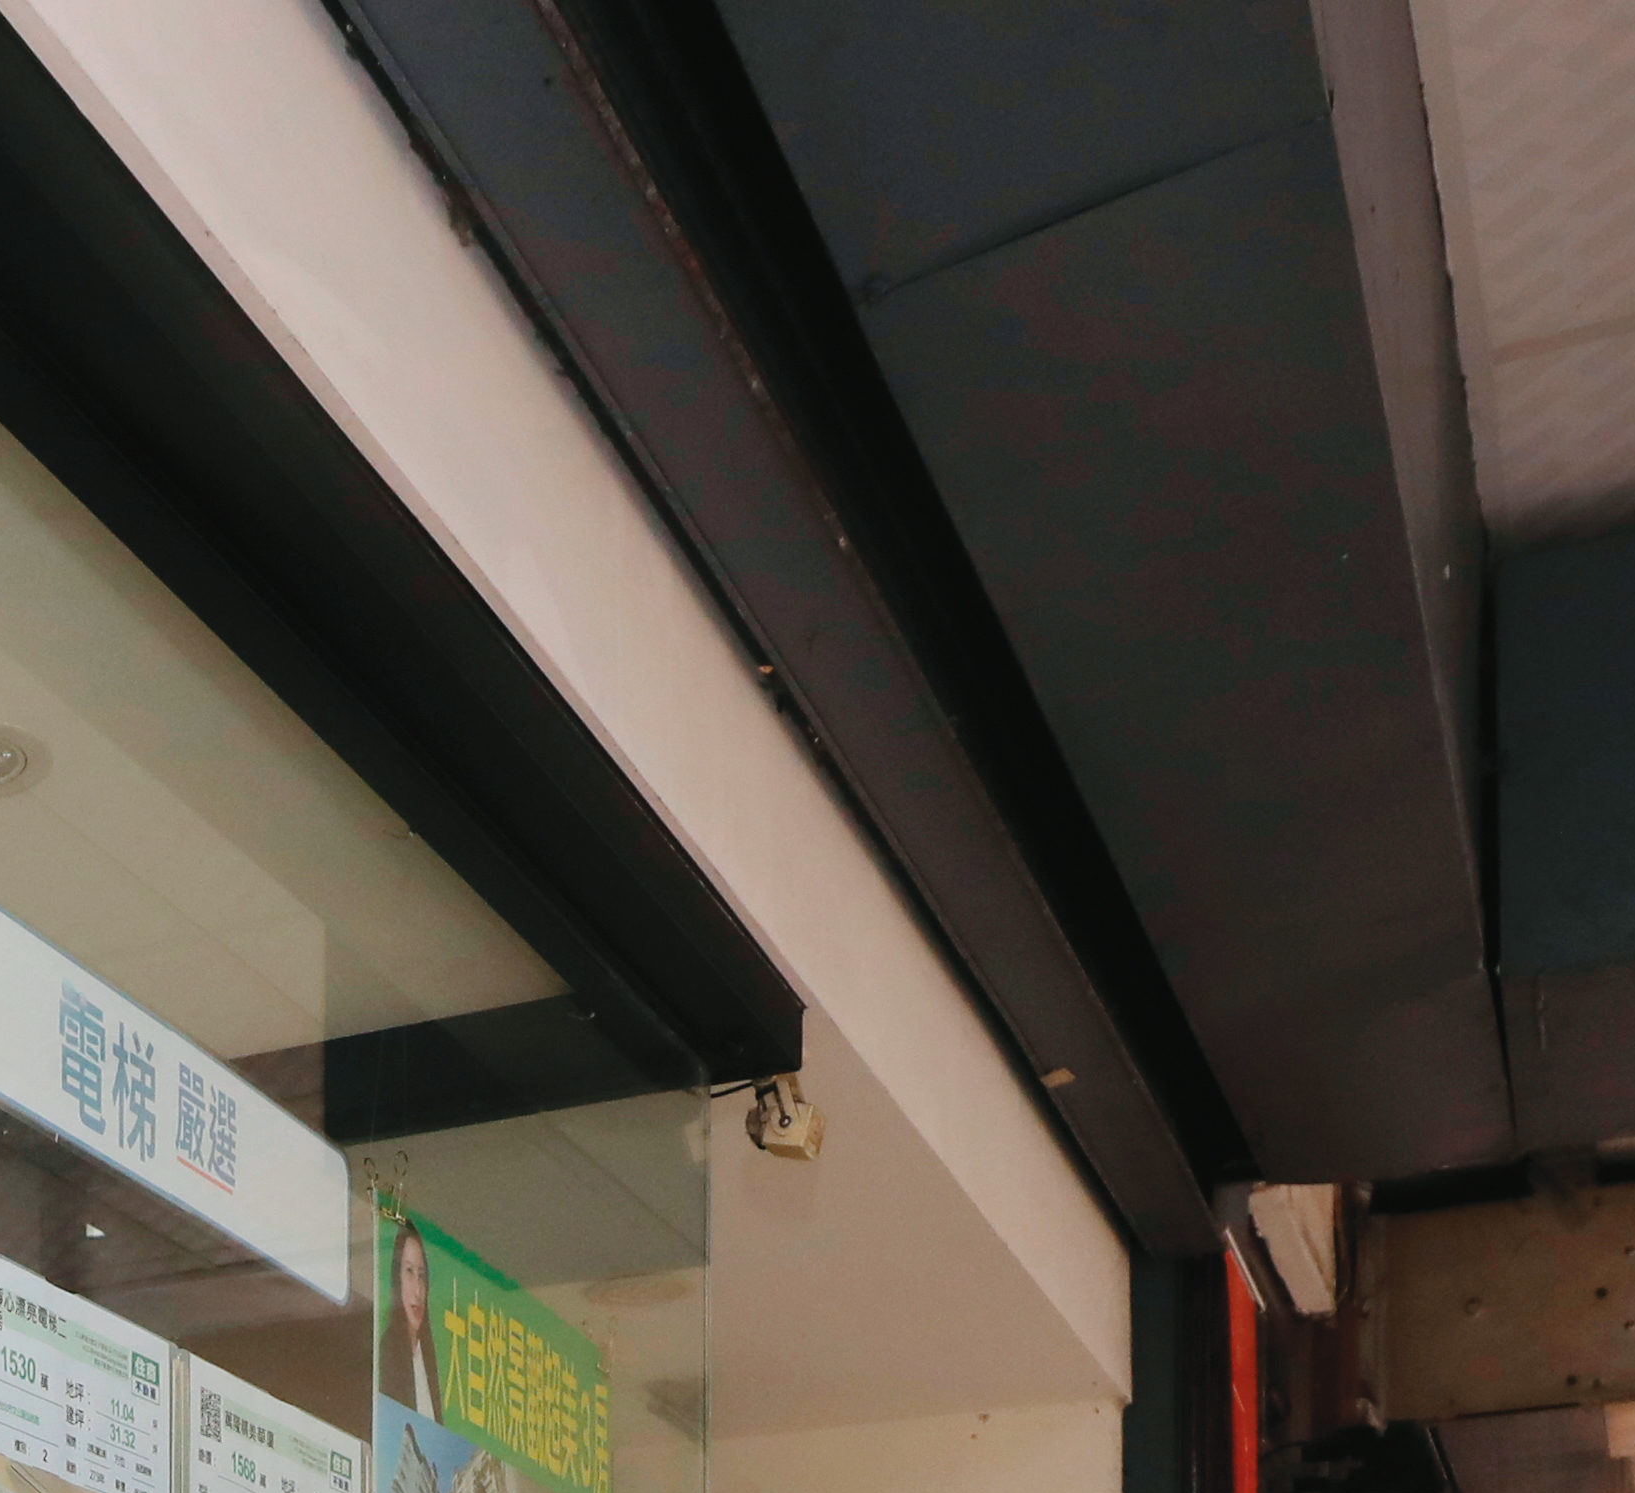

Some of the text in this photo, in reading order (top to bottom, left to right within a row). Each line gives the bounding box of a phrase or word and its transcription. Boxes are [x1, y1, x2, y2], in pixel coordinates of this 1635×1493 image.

[58, 978, 238, 1188] 電梯 嚴選
[1, 1345, 36, 1385] 1530
[109, 1398, 136, 1424] 11.04
[108, 1422, 136, 1450] 31.32
[231, 1451, 256, 1484] 1568
